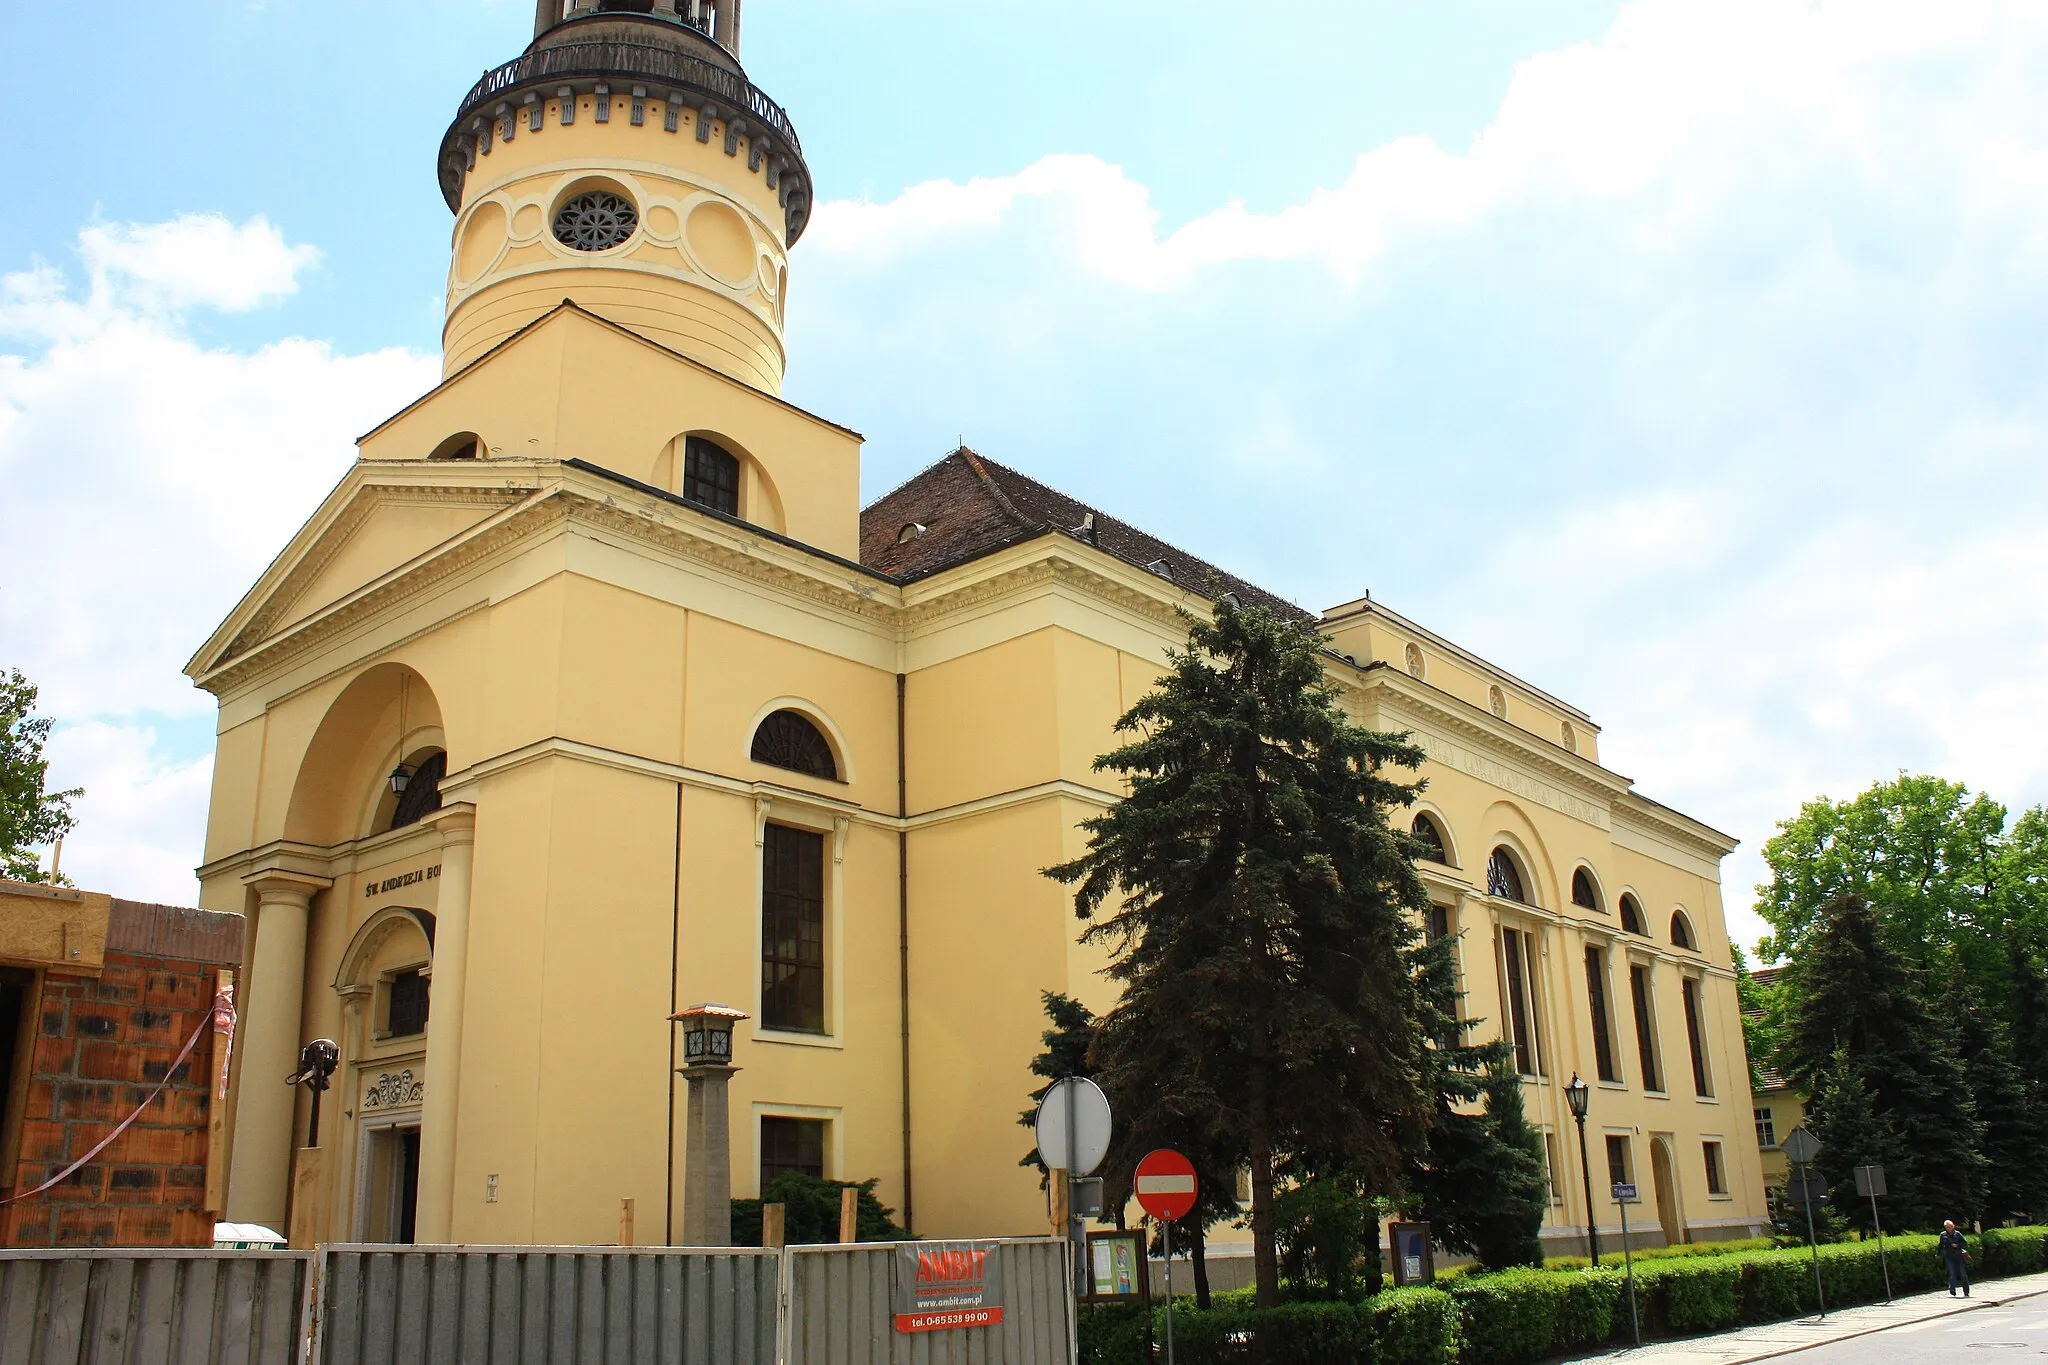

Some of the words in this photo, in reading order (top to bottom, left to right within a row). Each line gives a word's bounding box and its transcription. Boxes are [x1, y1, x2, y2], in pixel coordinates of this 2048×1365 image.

[381, 870, 423, 893] ANDRZEJA
[915, 1249, 986, 1283] AMBIT
[916, 1294, 982, 1308] www.ambit.com.pl
[912, 1318, 925, 1327] tel.
[947, 1314, 963, 1324] 538
[965, 1313, 976, 1322] 99
[977, 1312, 988, 1321] 00
